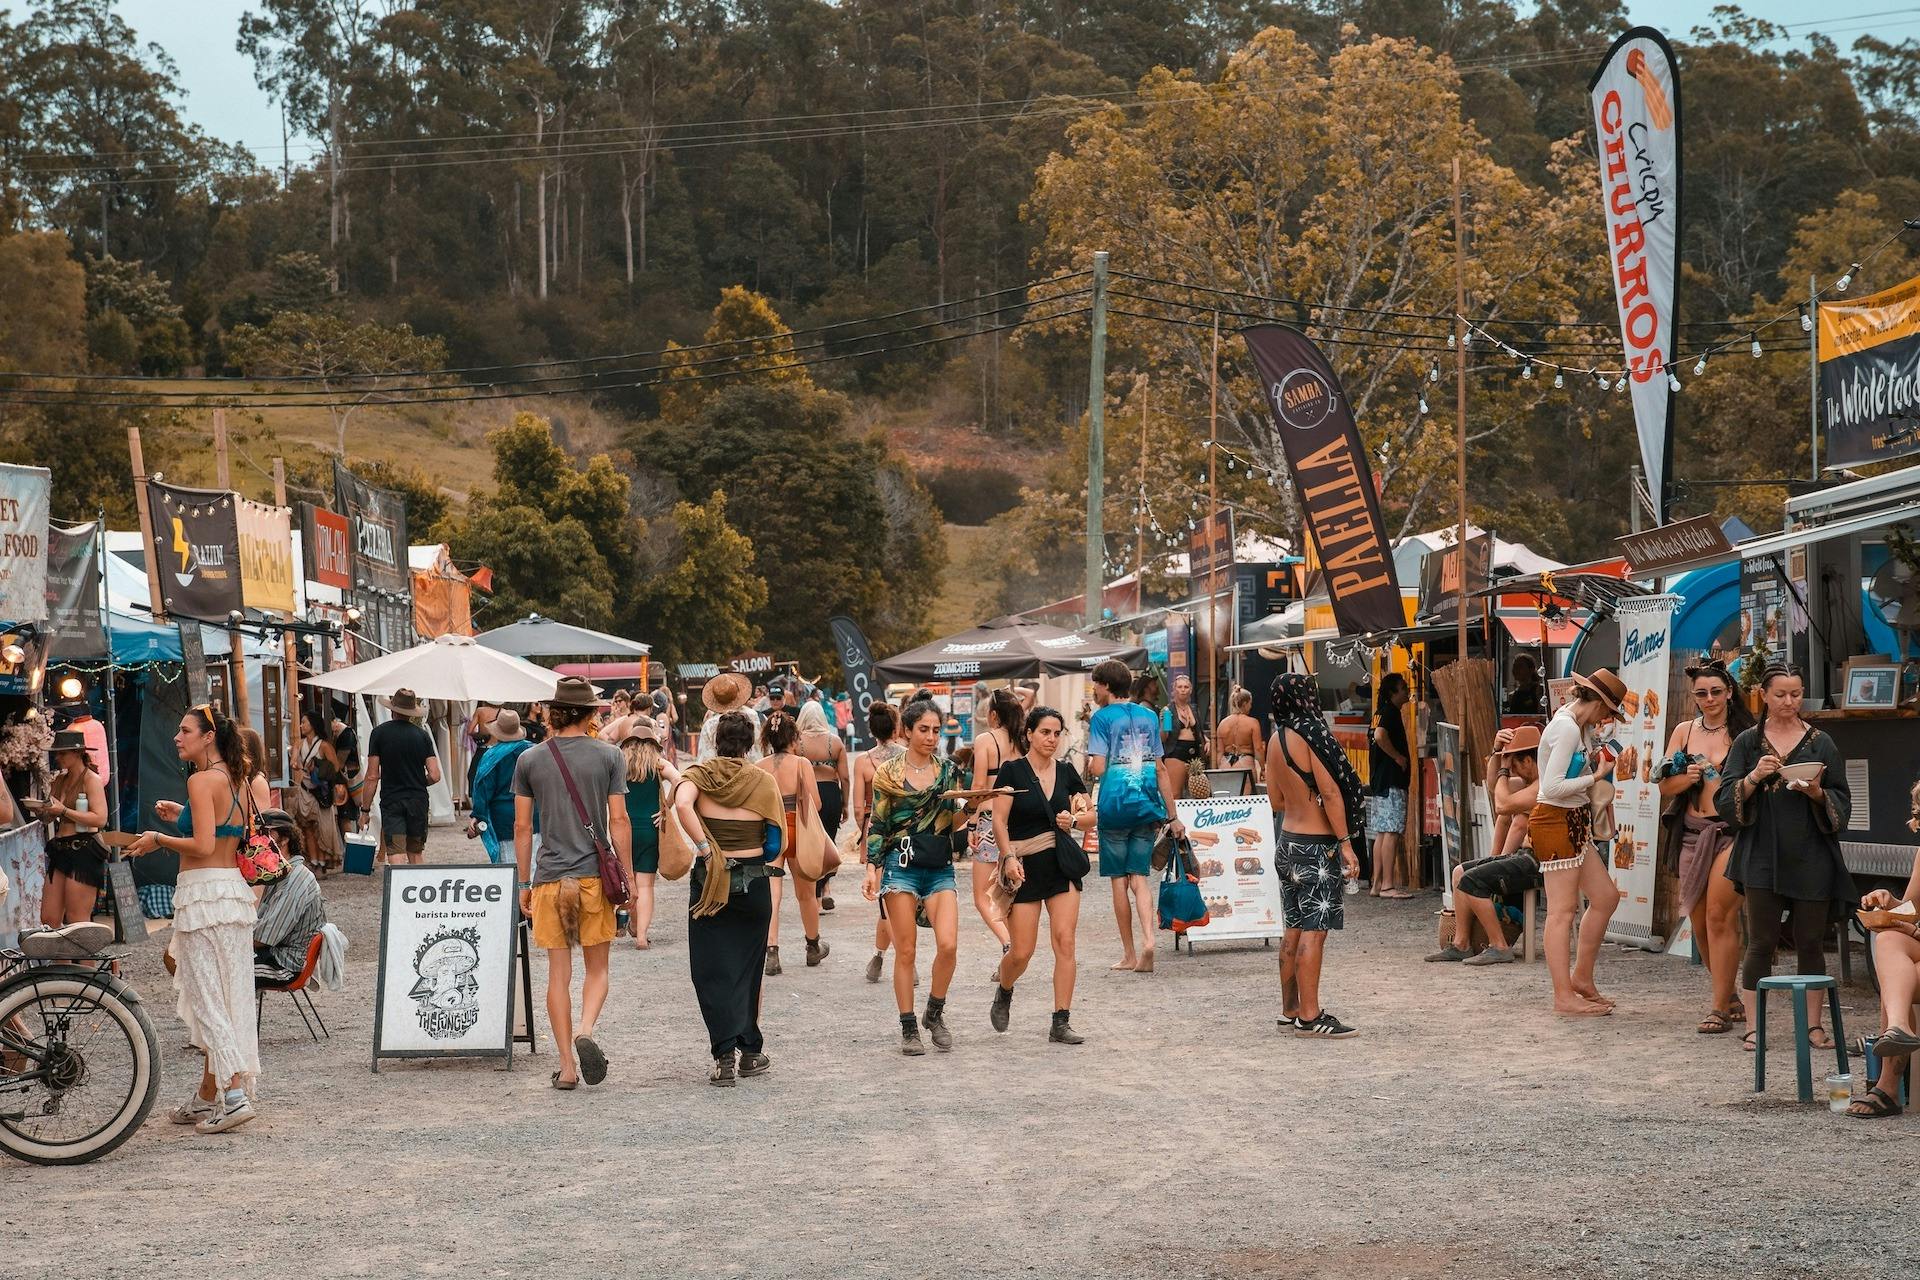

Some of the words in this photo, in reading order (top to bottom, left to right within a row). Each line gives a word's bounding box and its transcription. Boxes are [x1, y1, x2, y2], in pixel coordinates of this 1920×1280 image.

[1601, 90, 1662, 384] CHURROS
[1285, 381, 1323, 409] SAMBA
[1826, 397, 1841, 430] The
[1296, 434, 1390, 601] PAELLA
[4, 534, 38, 557] FOOD
[1622, 541, 1646, 565] The
[942, 640, 1010, 653] ZOOMCOFFEE
[1623, 628, 1666, 667] Churros
[731, 656, 772, 673] SALOON
[934, 661, 980, 675] ZOOMCOFFEE
[1194, 807, 1252, 829] Churros
[402, 879, 502, 903] coffee
[415, 911, 448, 919] barista
[451, 910, 486, 918] brewed
